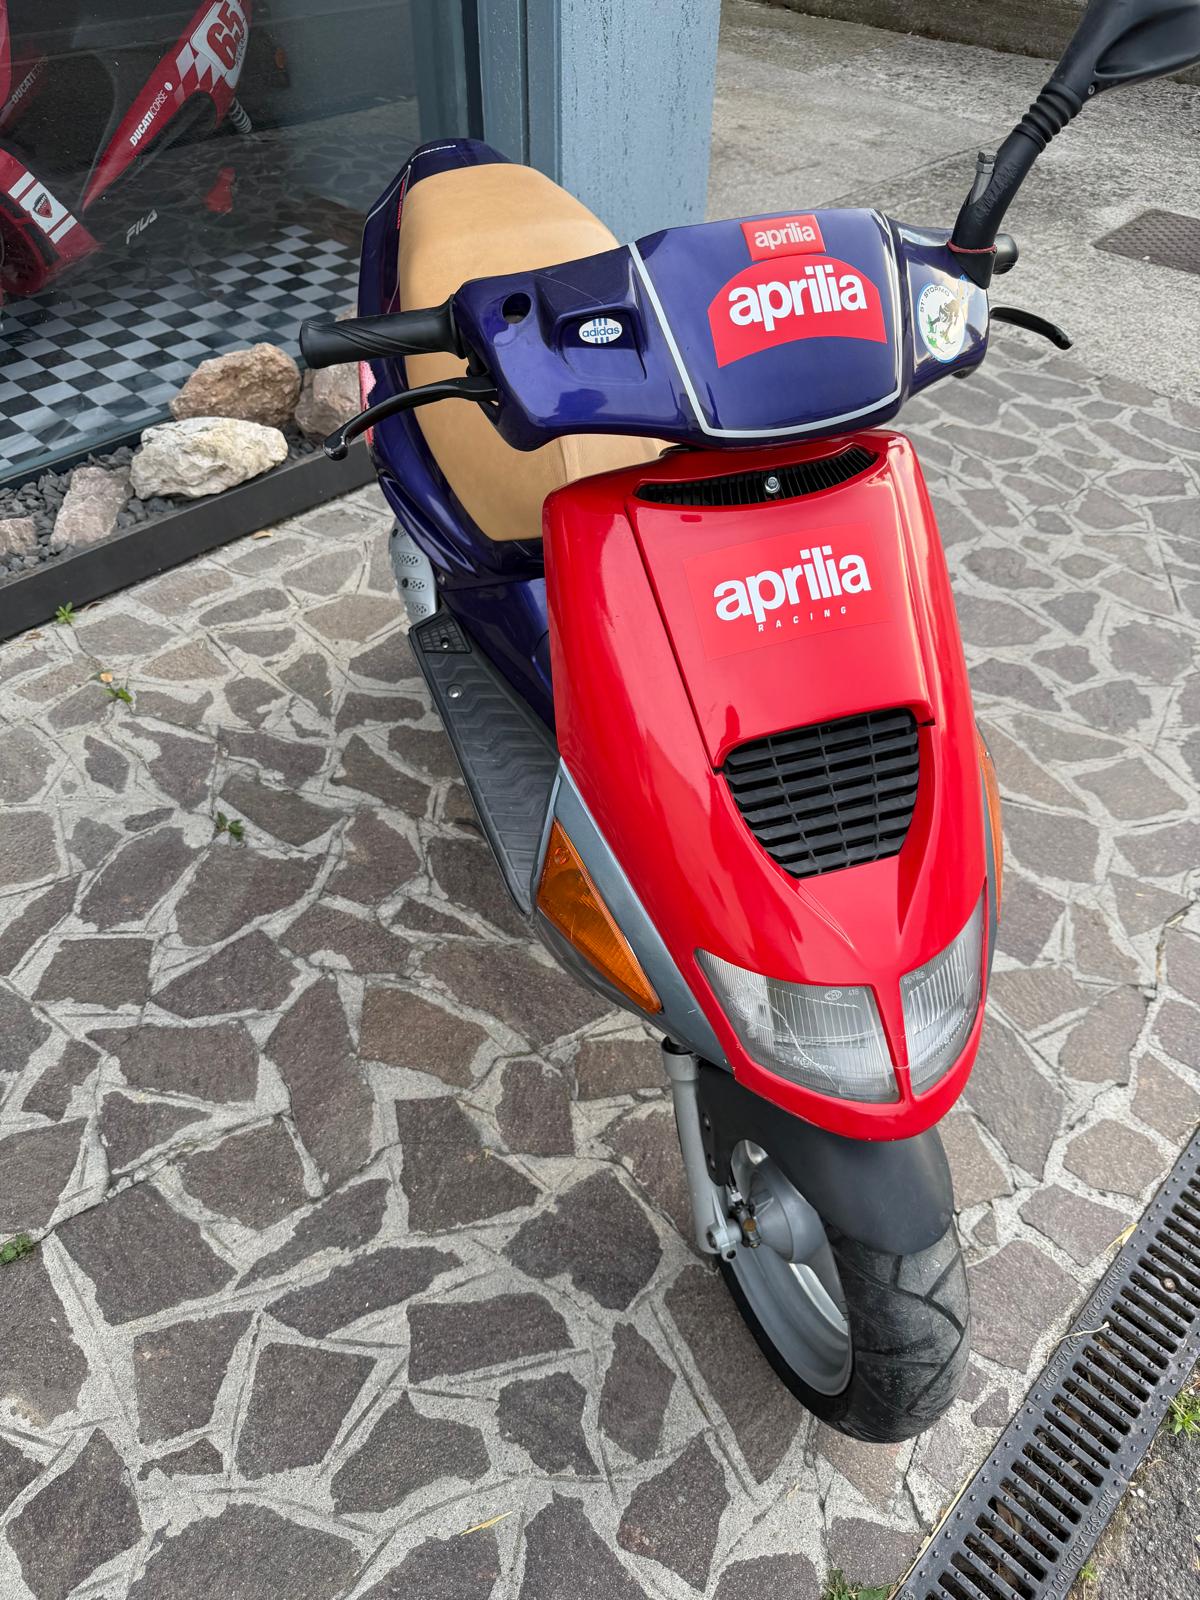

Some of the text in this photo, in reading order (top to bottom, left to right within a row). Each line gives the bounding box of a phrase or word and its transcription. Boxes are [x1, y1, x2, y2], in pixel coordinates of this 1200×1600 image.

[206, 1, 244, 70] 65
[126, 209, 157, 244] FILA
[755, 222, 816, 250] aprilia
[728, 264, 868, 331] aprilia
[582, 326, 620, 338] adidas
[713, 545, 872, 623] aprilia
[758, 606, 847, 632] RACING
